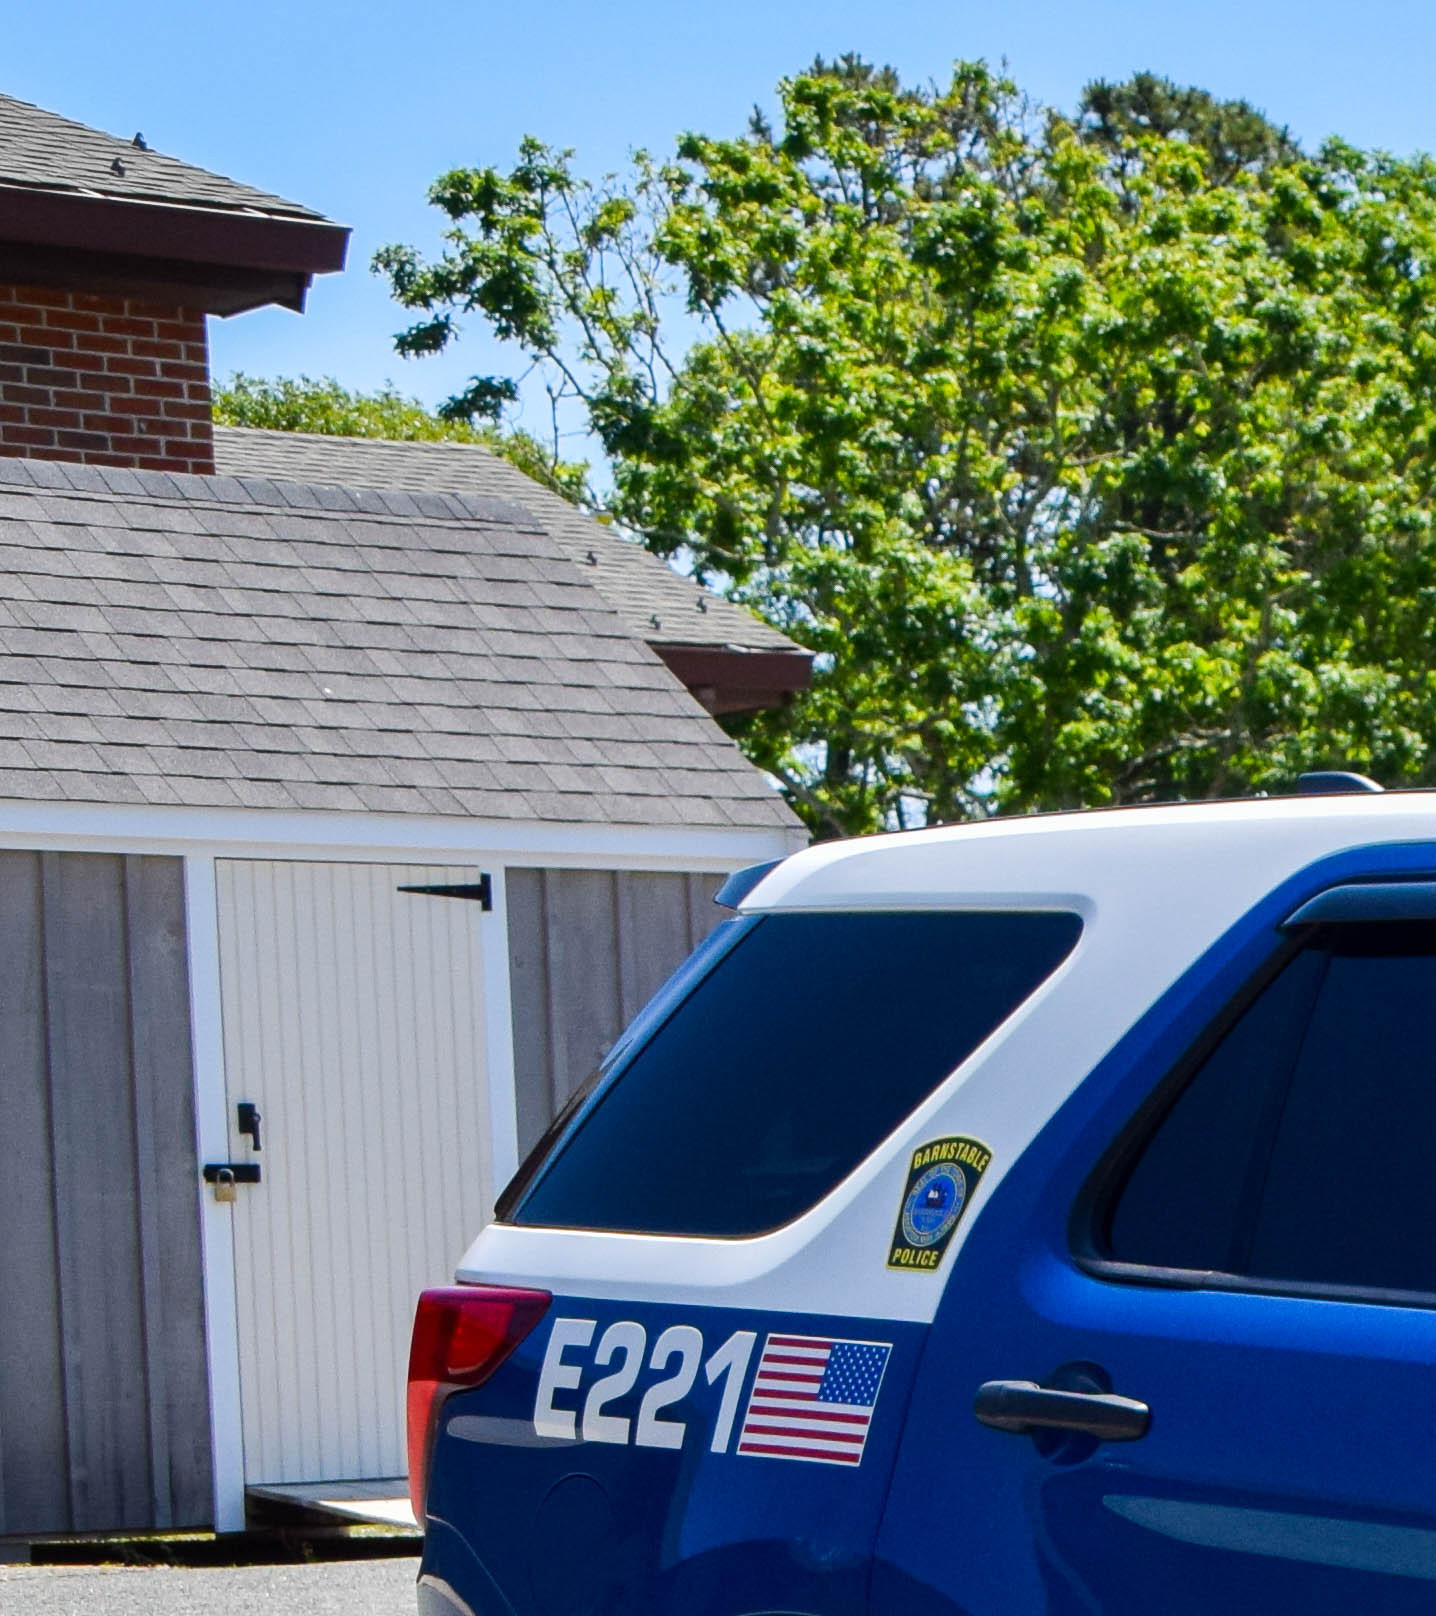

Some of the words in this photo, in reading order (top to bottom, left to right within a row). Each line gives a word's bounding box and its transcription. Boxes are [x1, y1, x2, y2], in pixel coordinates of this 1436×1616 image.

[914, 1142, 990, 1172] BARNSTABLE
[892, 1248, 939, 1266] POLICE
[533, 1317, 758, 1455] E221
